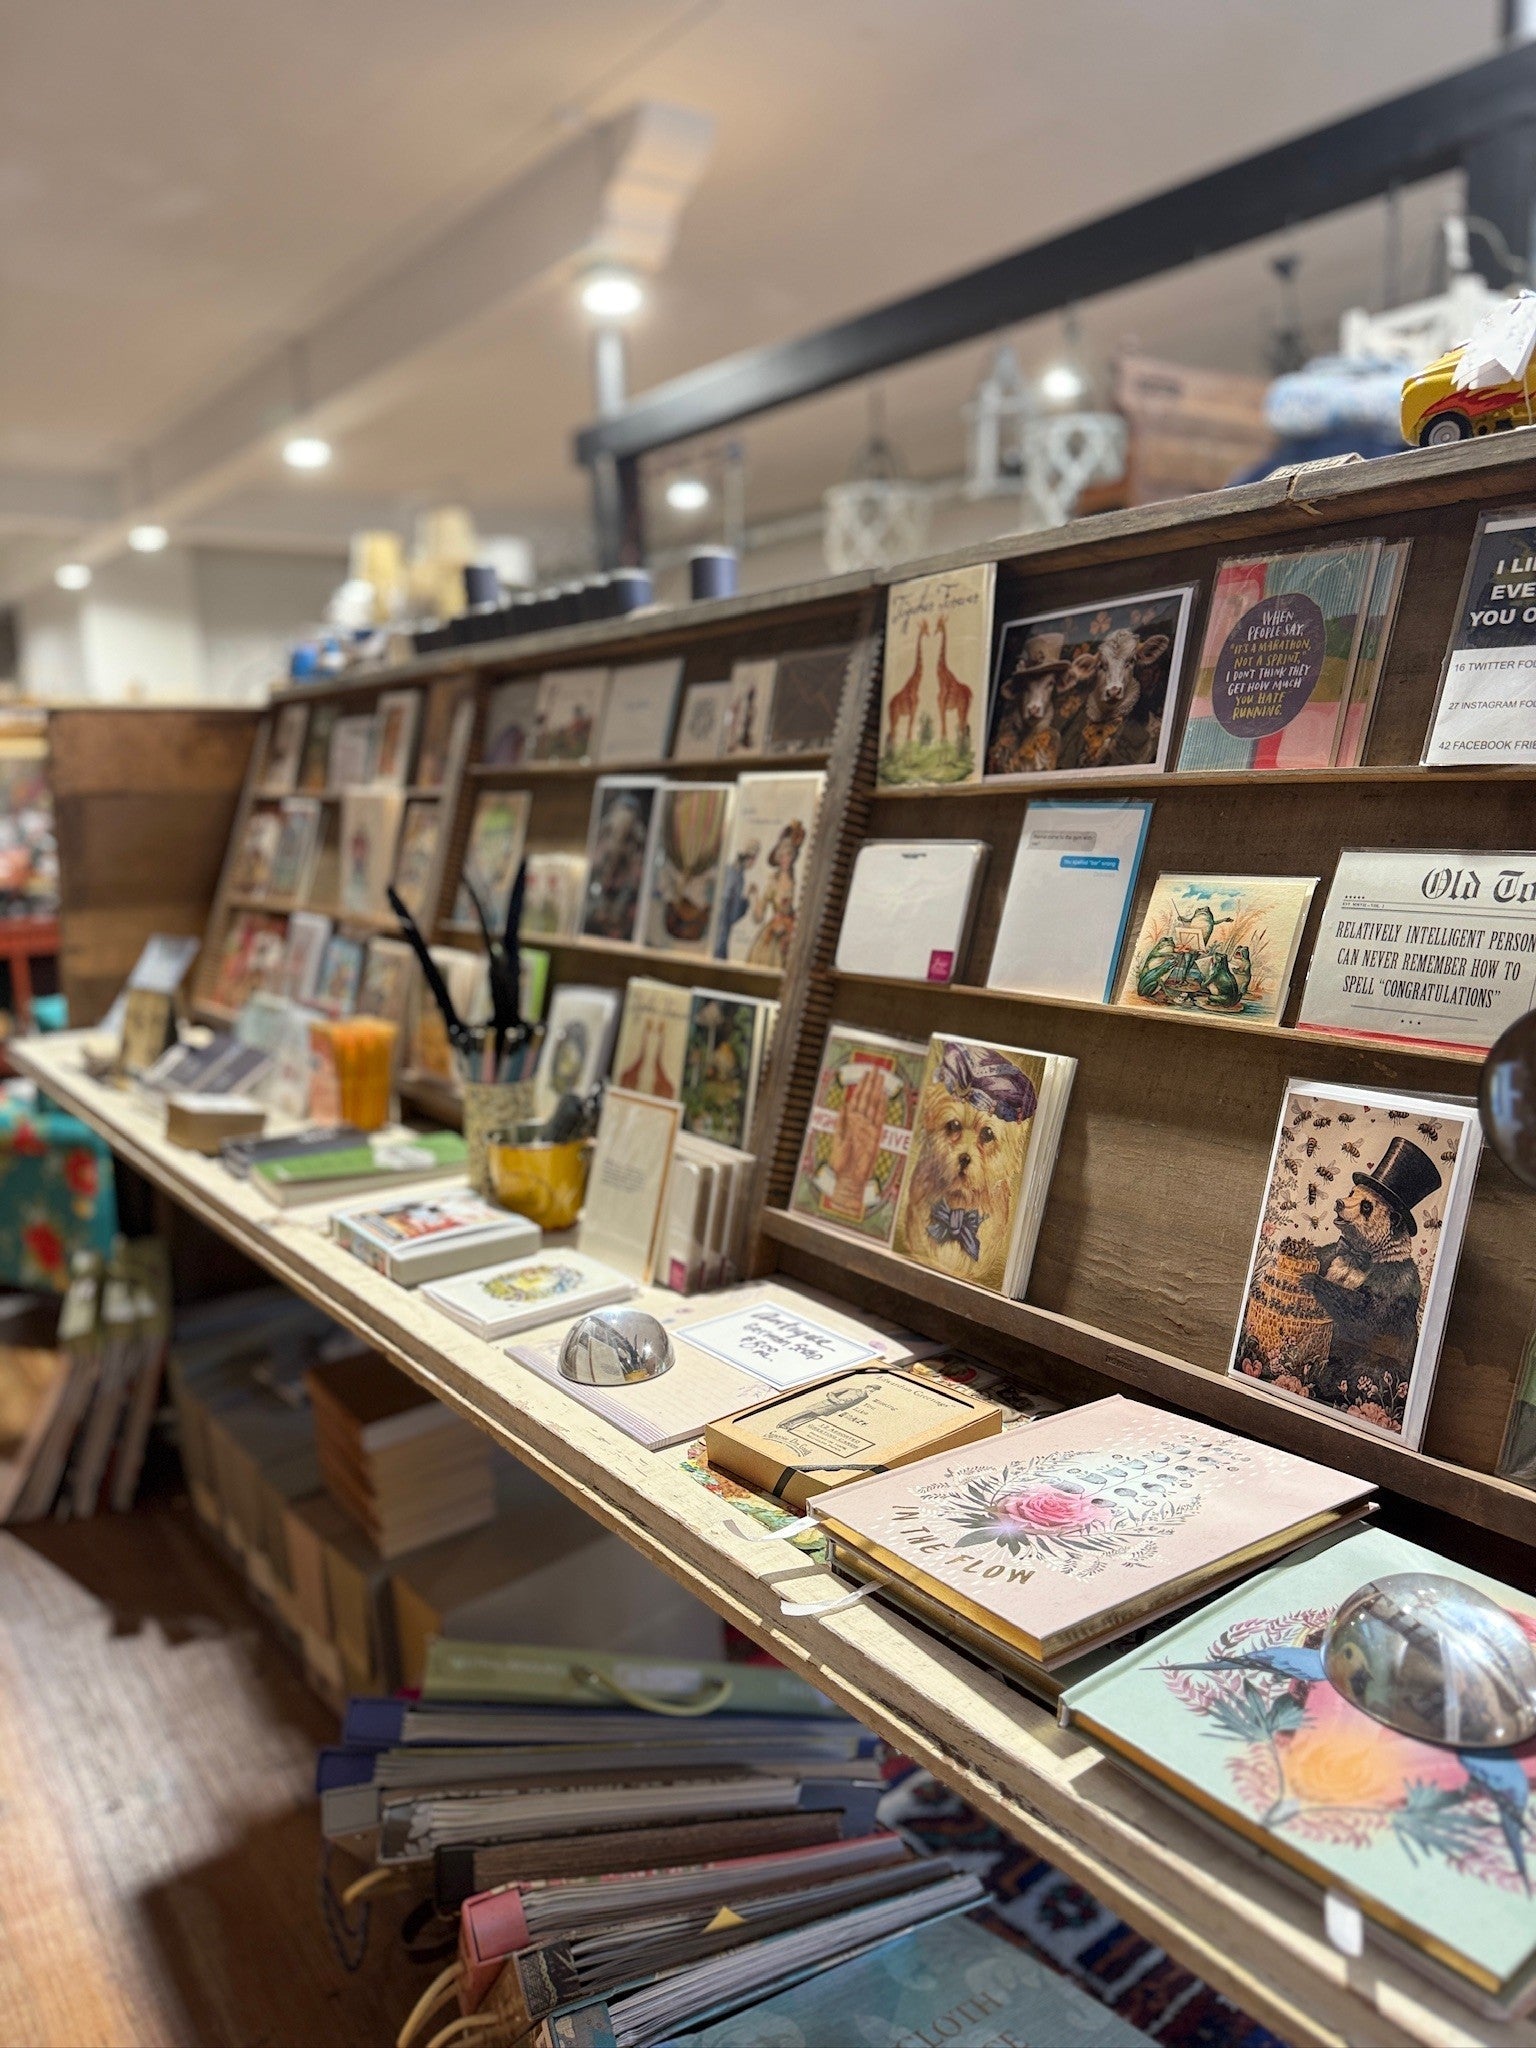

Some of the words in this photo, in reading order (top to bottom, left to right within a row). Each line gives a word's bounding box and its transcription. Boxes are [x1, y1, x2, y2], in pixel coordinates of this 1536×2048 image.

[1497, 560, 1505, 575] I
[1511, 556, 1536, 574] LI
[1262, 610, 1294, 626] WHEN
[1470, 609, 1517, 627] YOU
[1248, 625, 1281, 641] PEOPLE
[1251, 643, 1257, 653] A
[1234, 656, 1253, 669] NOT
[1256, 655, 1263, 667] A
[1454, 663, 1466, 672] 16
[1468, 660, 1515, 671] TWITTER
[1226, 670, 1231, 682] I
[1259, 666, 1287, 681] THINK
[1288, 663, 1311, 676] THEY
[1227, 682, 1246, 696] GET
[1247, 680, 1270, 693] HOW
[1272, 677, 1302, 691] MUCH
[1235, 694, 1254, 707] YOU
[1258, 691, 1287, 704] HATE
[1448, 702, 1459, 710] 27
[1461, 700, 1518, 710] INSTAGRAM
[1232, 704, 1282, 720] RUNNING.
[1439, 741, 1451, 751] 42
[1452, 740, 1512, 751] FACEBOOK
[1421, 867, 1481, 900] Old
[1335, 921, 1402, 943] RELATIVELY
[1405, 925, 1485, 949] INTELLIGENT
[1337, 947, 1360, 966] CAN
[1361, 949, 1399, 970] NEVER
[1401, 953, 1468, 977] REMEMBER
[1470, 958, 1500, 979] HOW
[1504, 961, 1521, 981] TO
[1342, 975, 1374, 995] SPELL
[1379, 978, 1501, 1008] "CONGRATULATIONS"
[883, 1128, 911, 1151] FIVE
[892, 1505, 920, 1521] IN
[900, 1525, 950, 1554] THE
[945, 1554, 1036, 1585] FLOW
